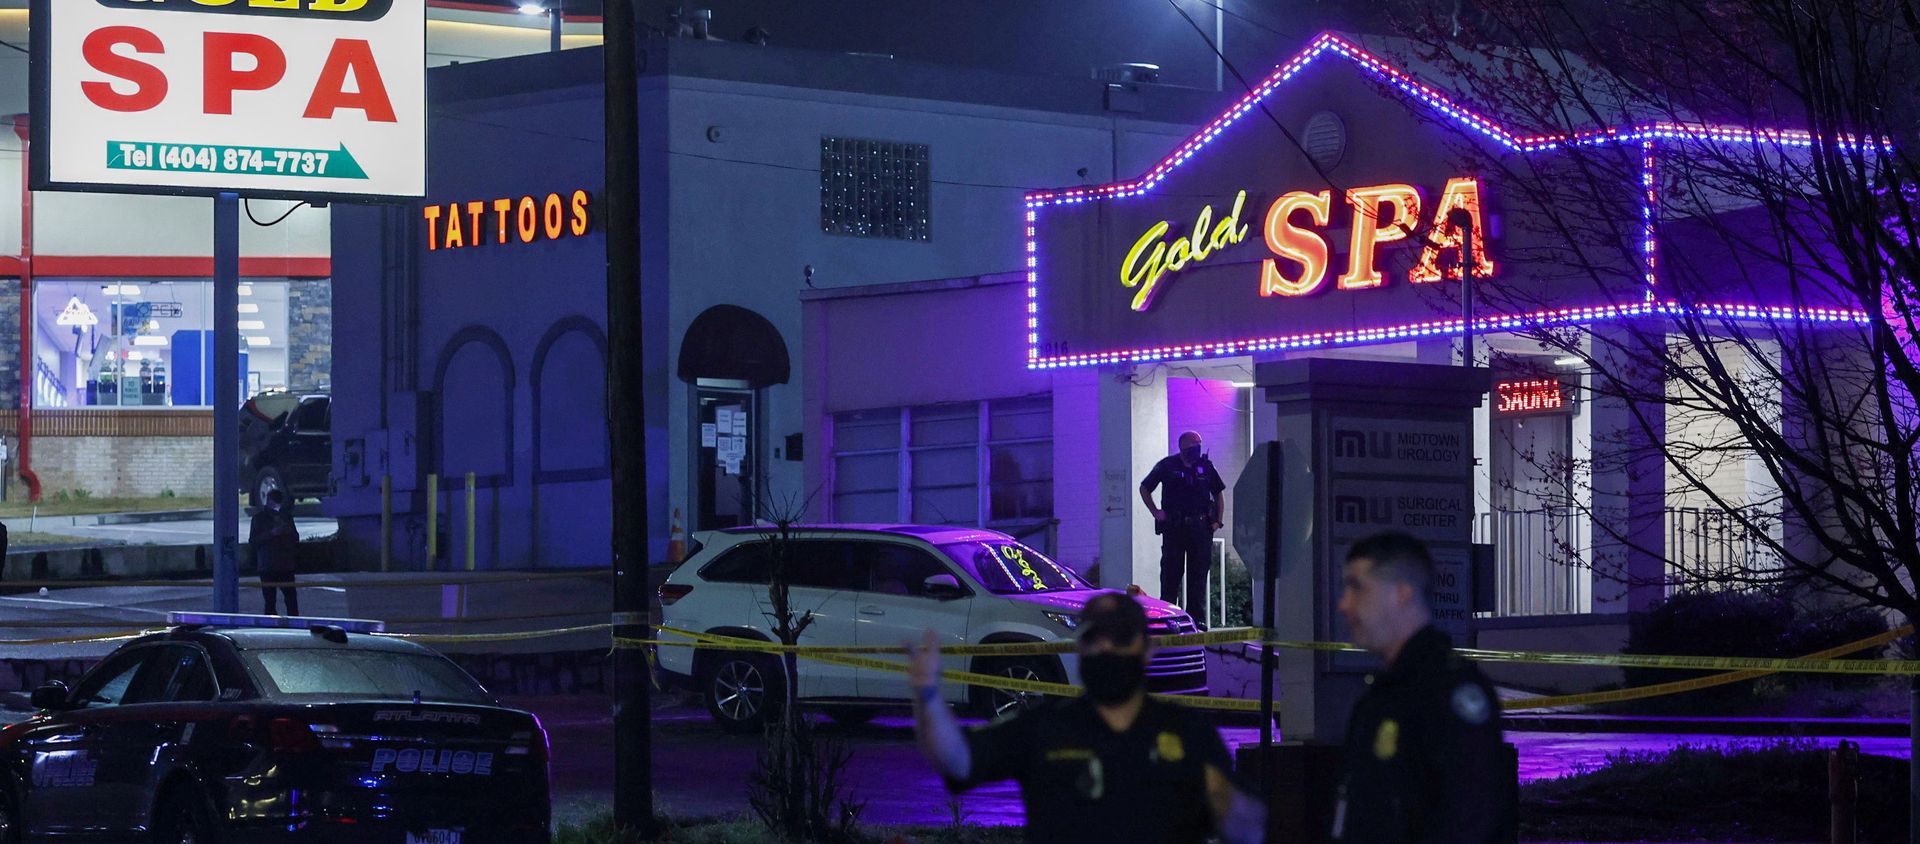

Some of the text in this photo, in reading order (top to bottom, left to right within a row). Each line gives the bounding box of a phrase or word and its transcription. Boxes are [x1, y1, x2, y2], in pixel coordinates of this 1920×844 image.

[80, 25, 398, 123] SPA
[119, 143, 329, 174] Tel (404) 874-7737
[424, 189, 588, 250] TATTOOS
[1120, 177, 1495, 310] Gold SPA
[1498, 380, 1561, 412] SAUNA
[1398, 432, 1459, 447] MIDTOWN
[1397, 448, 1460, 463] UROLOGY
[1398, 496, 1463, 512] SURGICAL
[1403, 513, 1457, 527] CENTER
[1436, 573, 1455, 587] NO
[1433, 592, 1459, 603] THRU
[371, 747, 494, 775] POLICE
